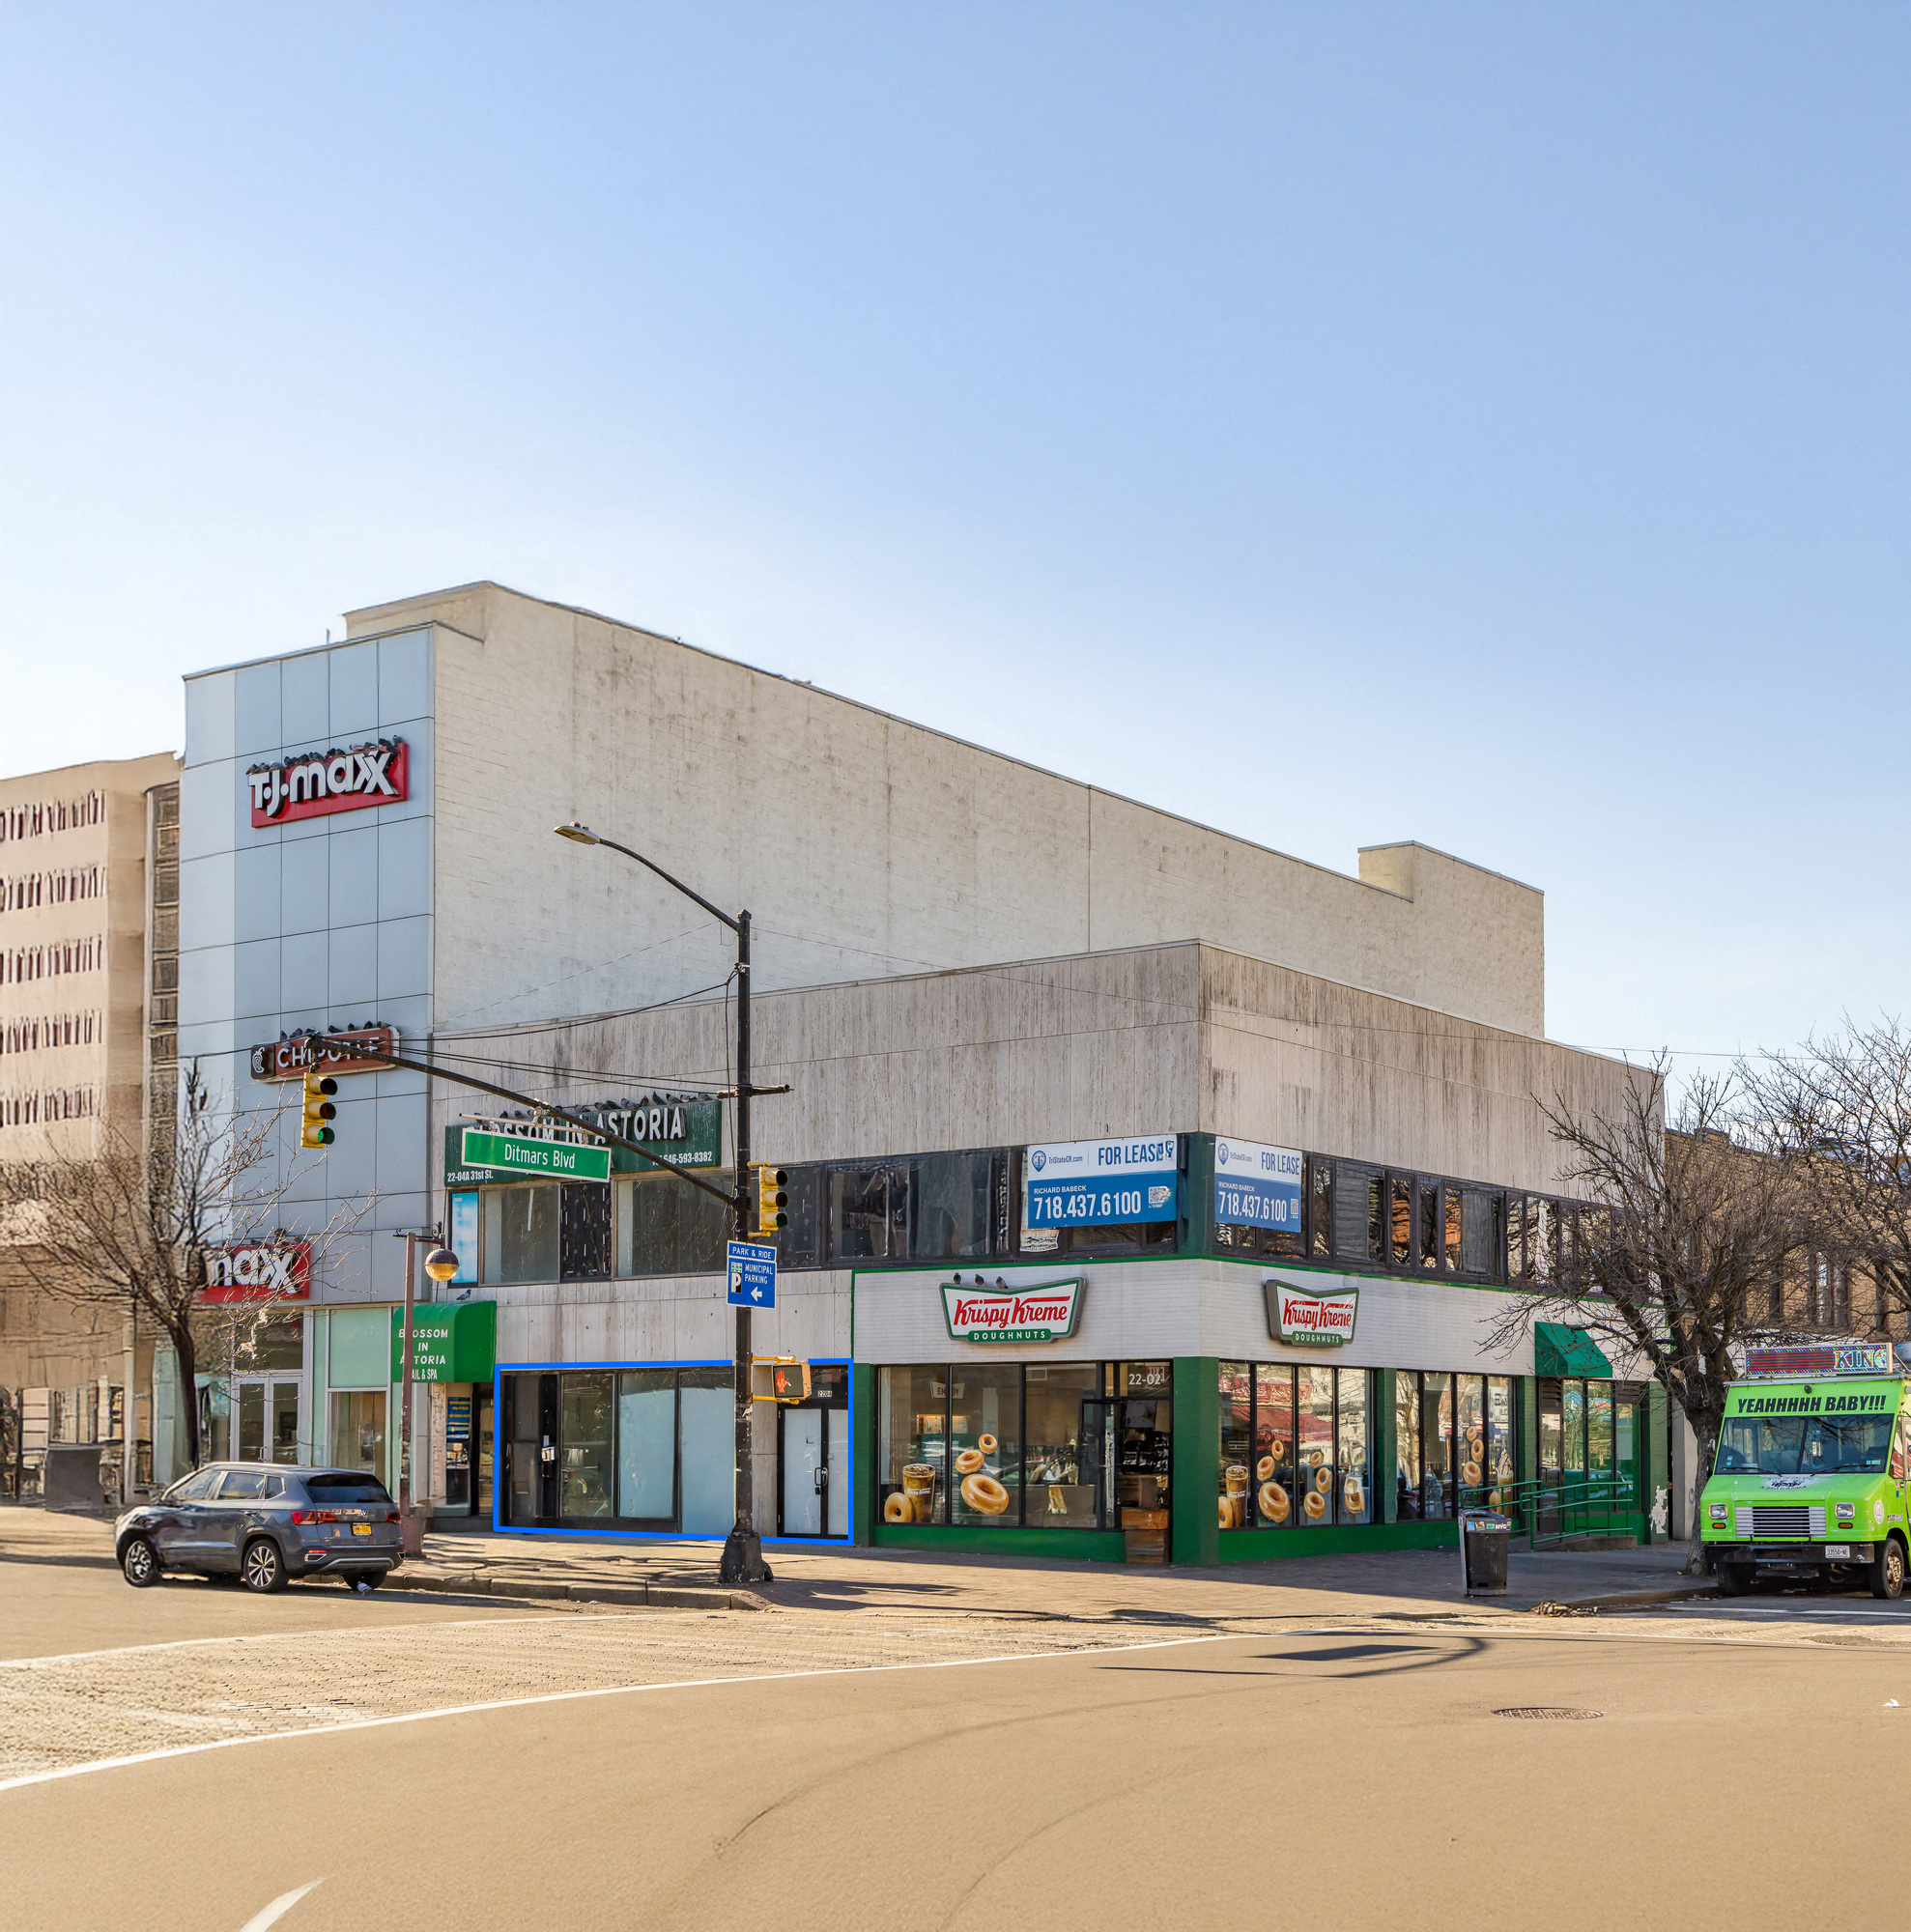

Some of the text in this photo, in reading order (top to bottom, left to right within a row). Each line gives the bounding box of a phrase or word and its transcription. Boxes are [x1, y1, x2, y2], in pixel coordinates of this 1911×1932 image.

[594, 1106, 682, 1146] ASTORIA
[504, 1143, 576, 1169] Ditmars Blvd
[663, 1151, 713, 1165] 646-593-8382
[1048, 1155, 1083, 1164] TriStateCR.com
[1098, 1146, 1122, 1166] FOR
[1261, 1151, 1299, 1176] FOR LEASE
[447, 1169, 494, 1181] 22-04A 31st St.
[1061, 1184, 1087, 1193] BABECK
[1218, 1181, 1255, 1192] RICHARD BABECK
[1034, 1190, 1142, 1220] 718.437.6100
[1218, 1190, 1287, 1222] 718.437.6100
[732, 1246, 750, 1256] PARK
[757, 1250, 772, 1260] RIDE
[744, 1263, 774, 1275] MUNICIPAL
[730, 1272, 742, 1293] P
[744, 1273, 768, 1285] PARKING
[953, 1295, 1071, 1329] Krispy Kreme
[1282, 1298, 1355, 1331] Krispy Kreme
[398, 1328, 449, 1339] BOSSOM
[973, 1330, 1046, 1341] DOUGHNUTS
[1295, 1333, 1340, 1344] DOUGHNUTS
[417, 1342, 429, 1352] IN
[399, 1354, 446, 1365] ATORIA
[411, 1369, 438, 1380] AIL & SPA
[1127, 1373, 1161, 1385] 22-02
[937, 1386, 959, 1397] ENOY
[1737, 1395, 1887, 1414] YEAHHHHH BABY!!!
